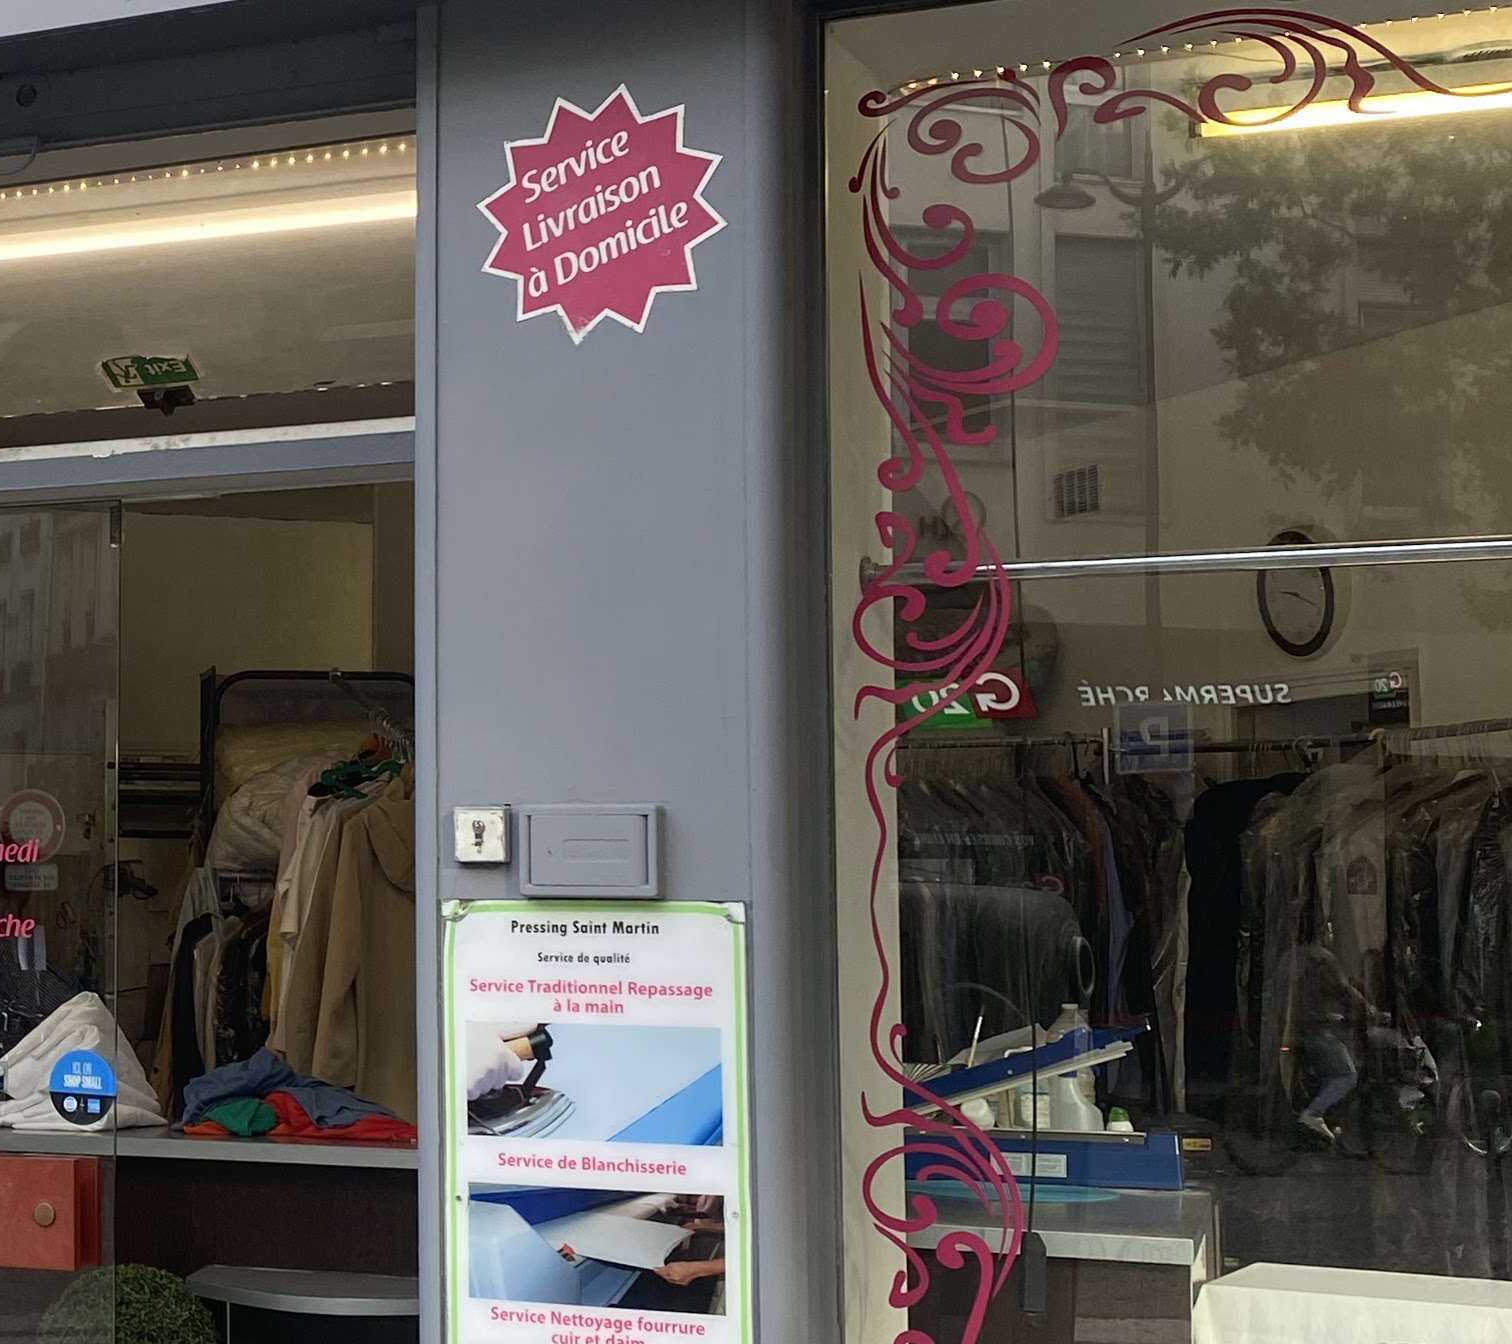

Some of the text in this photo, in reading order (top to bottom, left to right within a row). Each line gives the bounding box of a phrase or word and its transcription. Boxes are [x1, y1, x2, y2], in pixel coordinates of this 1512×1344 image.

[521, 130, 630, 204] Service
[522, 165, 662, 252] Livraison
[527, 201, 689, 298] à Domicile
[143, 360, 187, 376] Exit
[510, 920, 660, 937] Pressing Saint Martin
[537, 952, 630, 966] Service de qualité
[469, 978, 714, 1000] Service Traditionnel Repassage
[552, 998, 624, 1014] à la main
[498, 1152, 687, 1175] Service de Blanchisserie
[490, 1306, 706, 1336] Service Nettoyage fourrure
